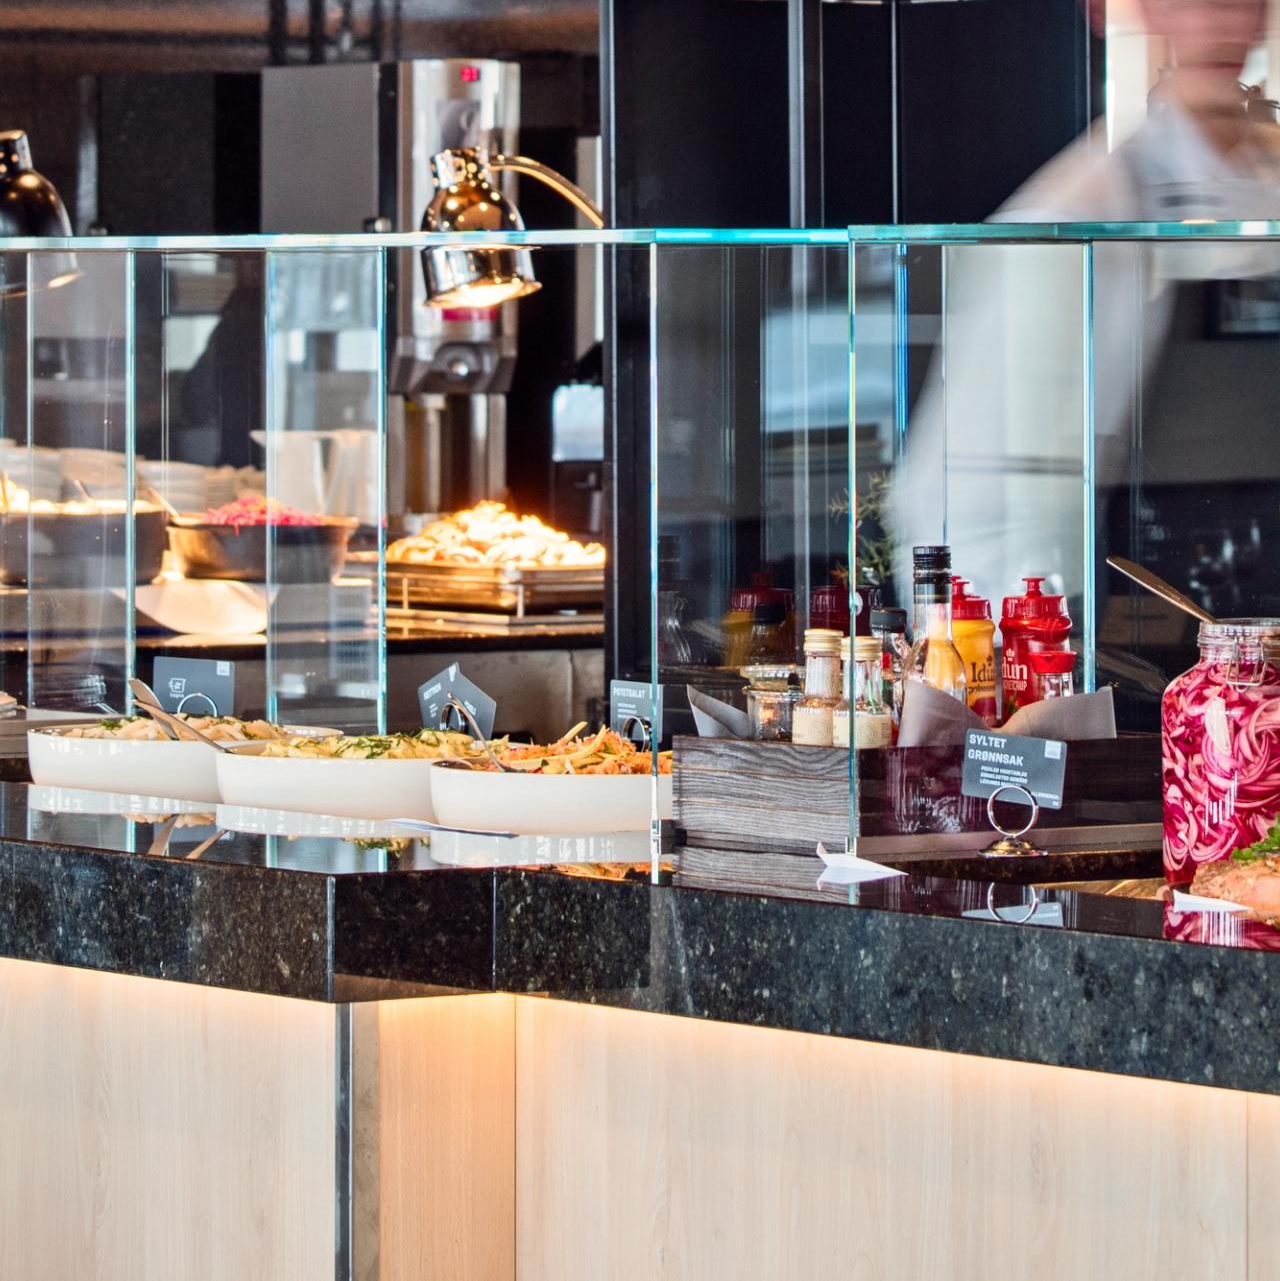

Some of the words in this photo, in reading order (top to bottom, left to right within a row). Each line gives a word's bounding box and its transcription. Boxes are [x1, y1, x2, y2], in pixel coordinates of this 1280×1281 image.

[1002, 655, 1028, 680] dun
[969, 734, 1007, 749] SYLTET
[968, 749, 1024, 766] GRØNNSAK
